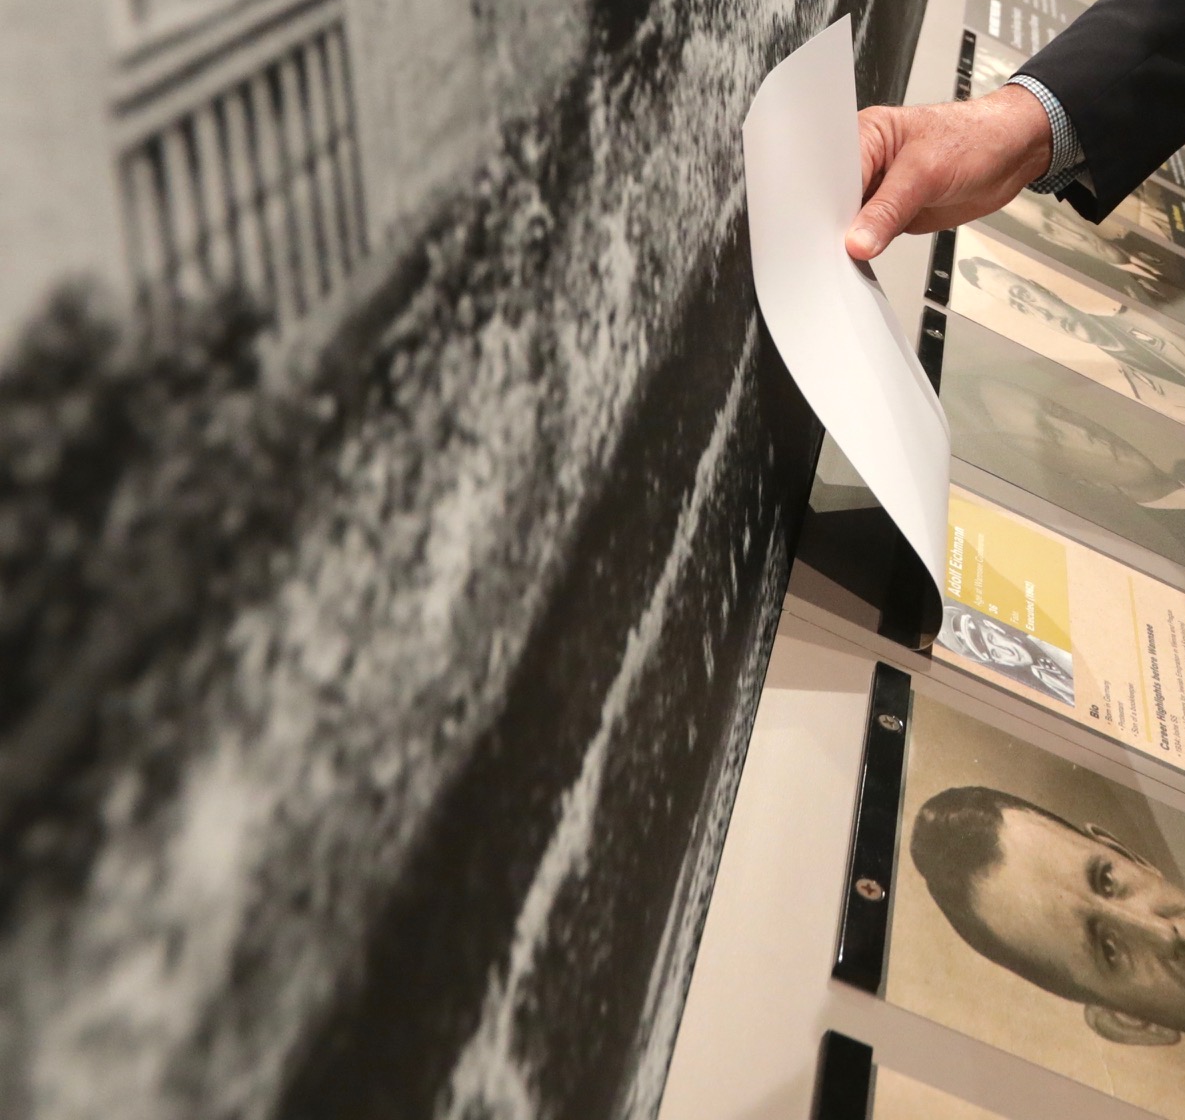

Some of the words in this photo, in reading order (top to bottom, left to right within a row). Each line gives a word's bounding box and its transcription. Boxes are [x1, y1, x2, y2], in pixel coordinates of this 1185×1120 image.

[949, 525, 964, 570] Eichmann
[947, 567, 961, 597] Adolf
[988, 602, 997, 614] 36
[1025, 599, 1034, 631] Executed
[1147, 623, 1156, 656] Wannsee
[1151, 656, 1160, 681] before
[1089, 703, 1098, 719] Bio
[1155, 681, 1167, 723] Highlights
[1159, 721, 1169, 751] Career
